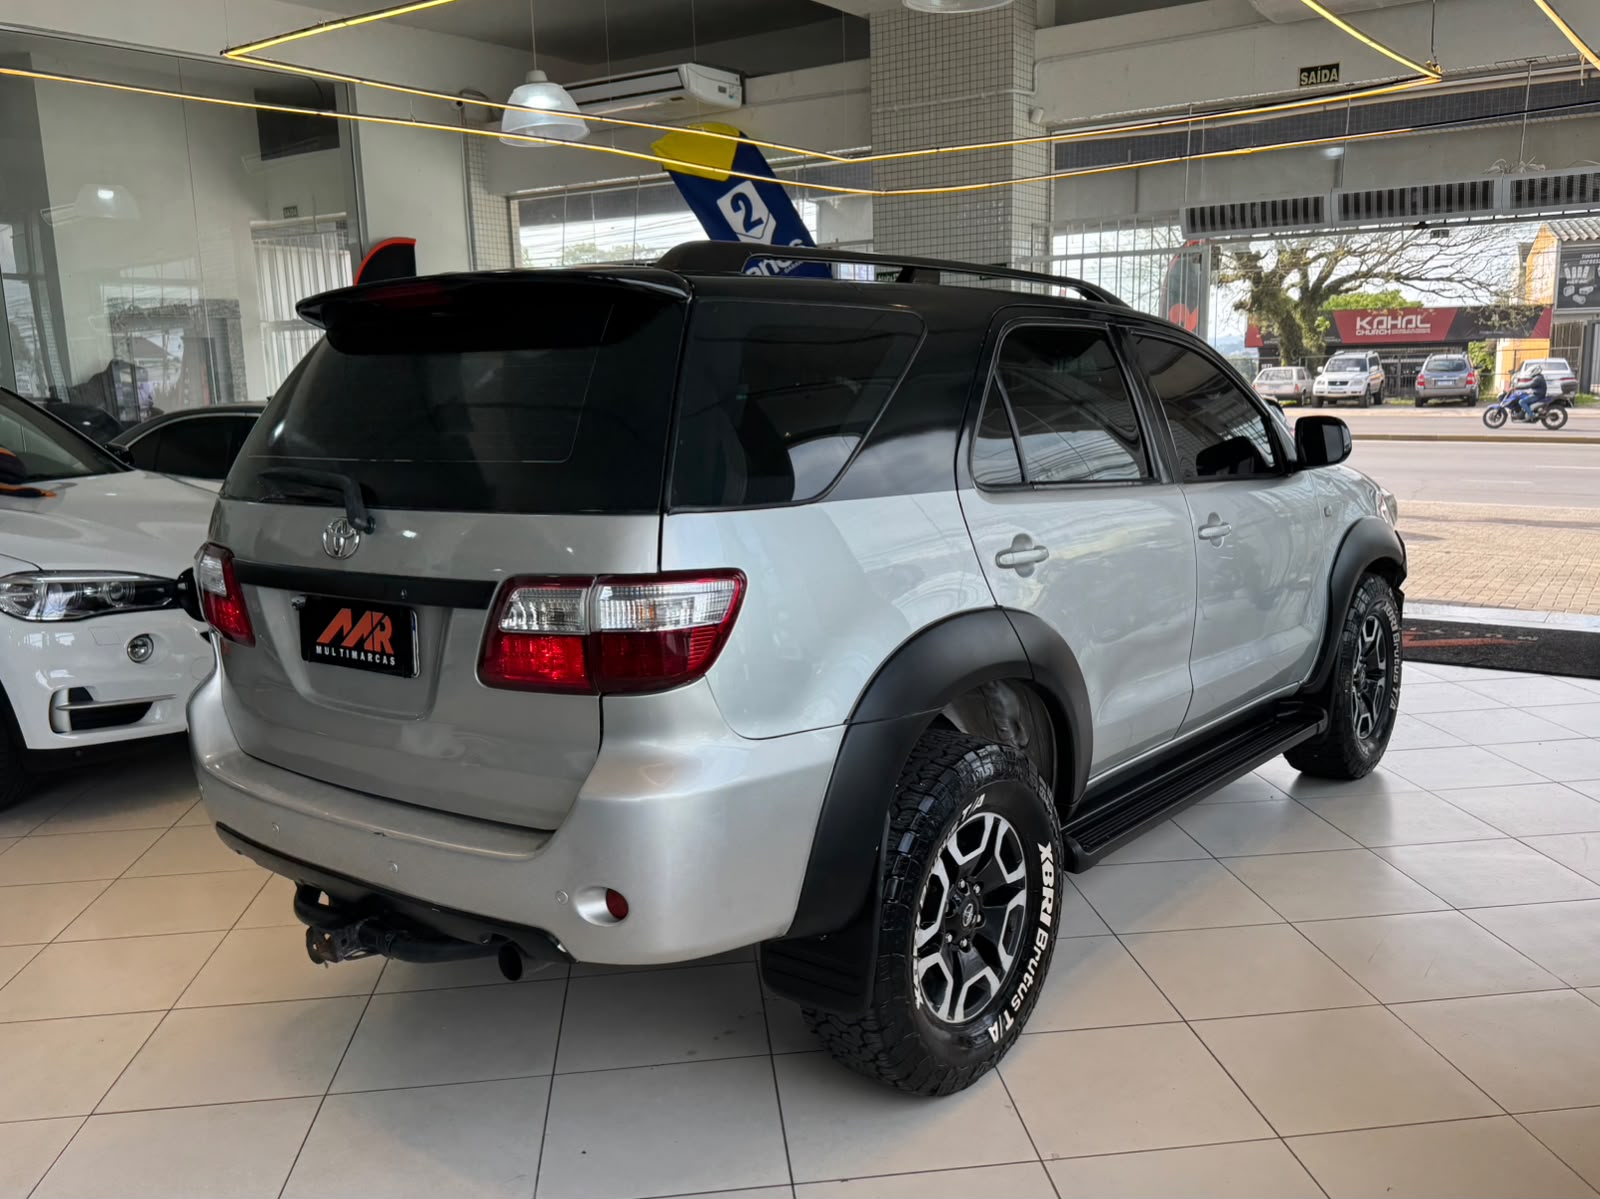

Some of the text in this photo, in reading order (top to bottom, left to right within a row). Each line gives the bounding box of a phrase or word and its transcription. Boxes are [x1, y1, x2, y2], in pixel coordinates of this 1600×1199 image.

[1300, 66, 1338, 85] SAÍDA
[730, 192, 764, 233] 2
[1355, 328, 1391, 336] CHURCH
[1356, 314, 1431, 330] KAHAL
[316, 645, 395, 666] MULTIMARCAS
[987, 842, 1055, 1044] XBRI Brutus T/A
